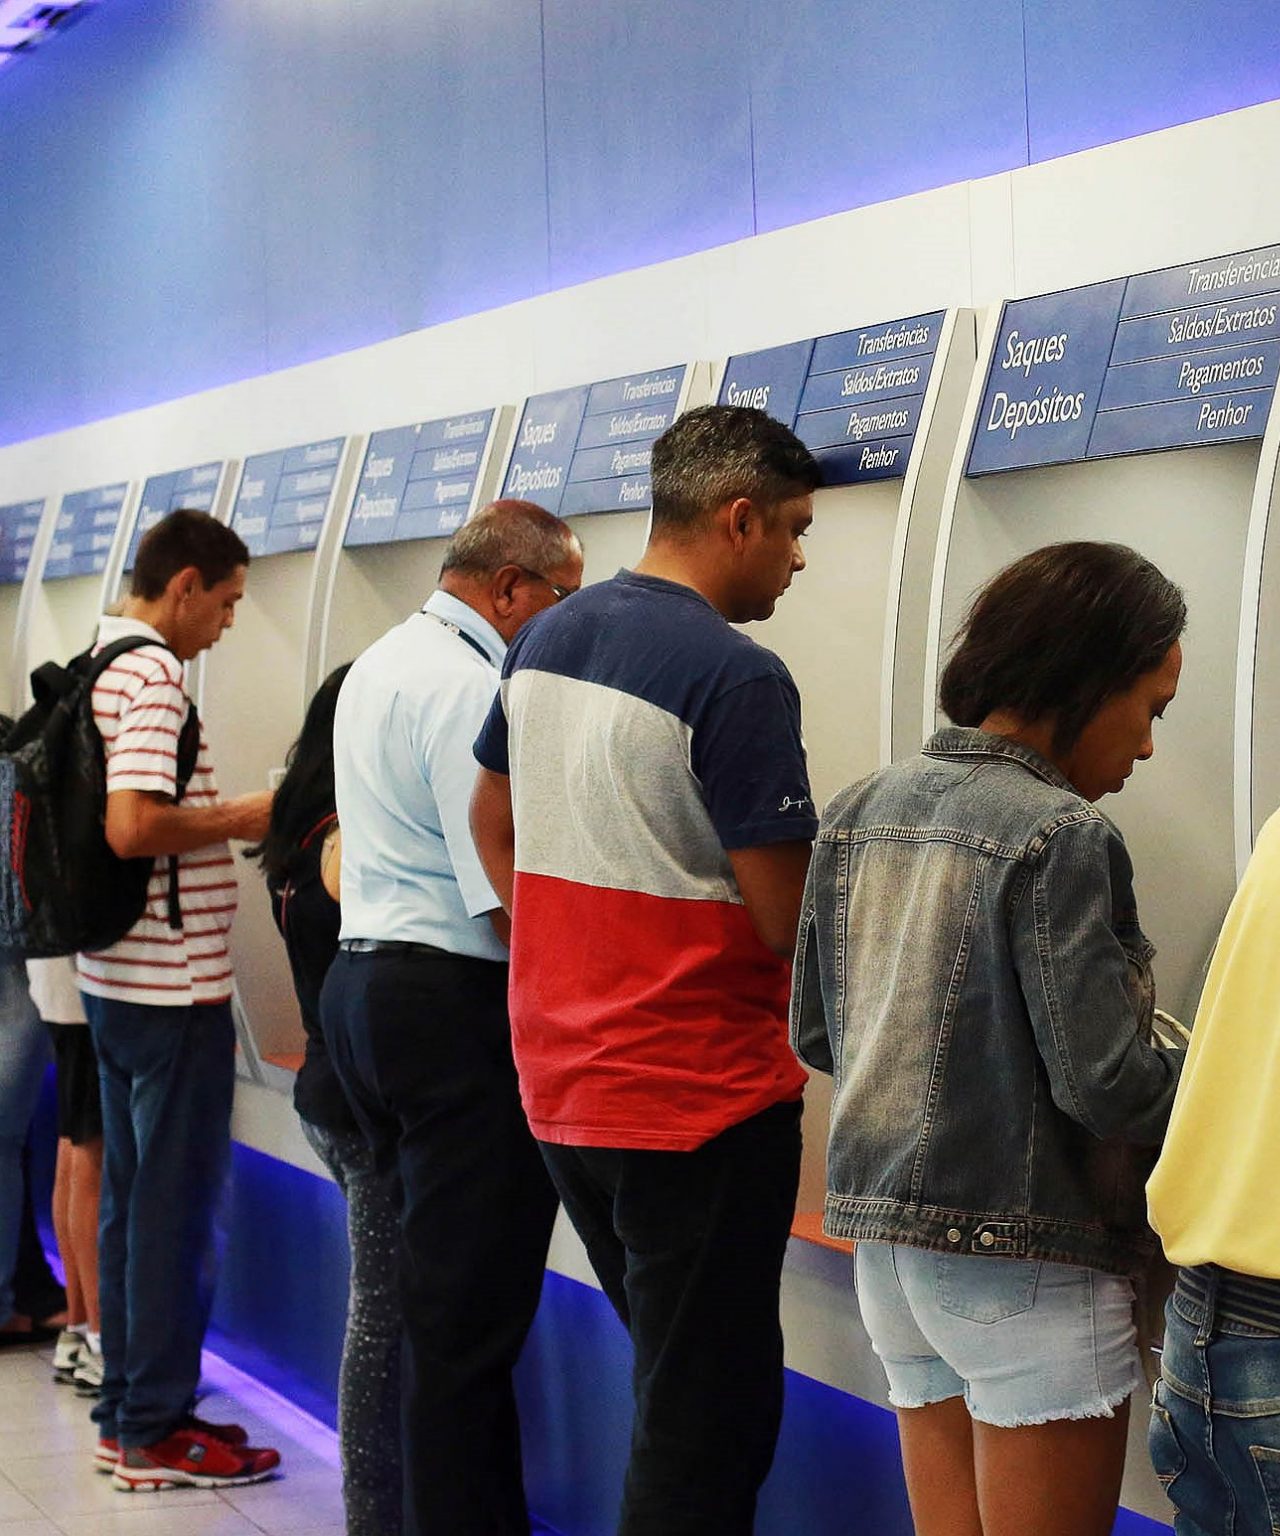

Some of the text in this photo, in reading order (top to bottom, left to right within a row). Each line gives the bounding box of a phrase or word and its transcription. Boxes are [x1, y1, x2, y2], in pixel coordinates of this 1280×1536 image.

[856, 324, 930, 357] Transferências
[1168, 305, 1277, 345] Saldos/Extratos
[1002, 330, 1068, 378] Saques
[841, 365, 920, 397] Saldos/Extratos
[1178, 355, 1265, 394] Pagamentos
[846, 407, 909, 440] Pagamentos
[987, 386, 1085, 440] Depósitos
[1196, 399, 1253, 432] Penhor
[520, 418, 558, 455] Saques
[858, 445, 899, 471] Penhor
